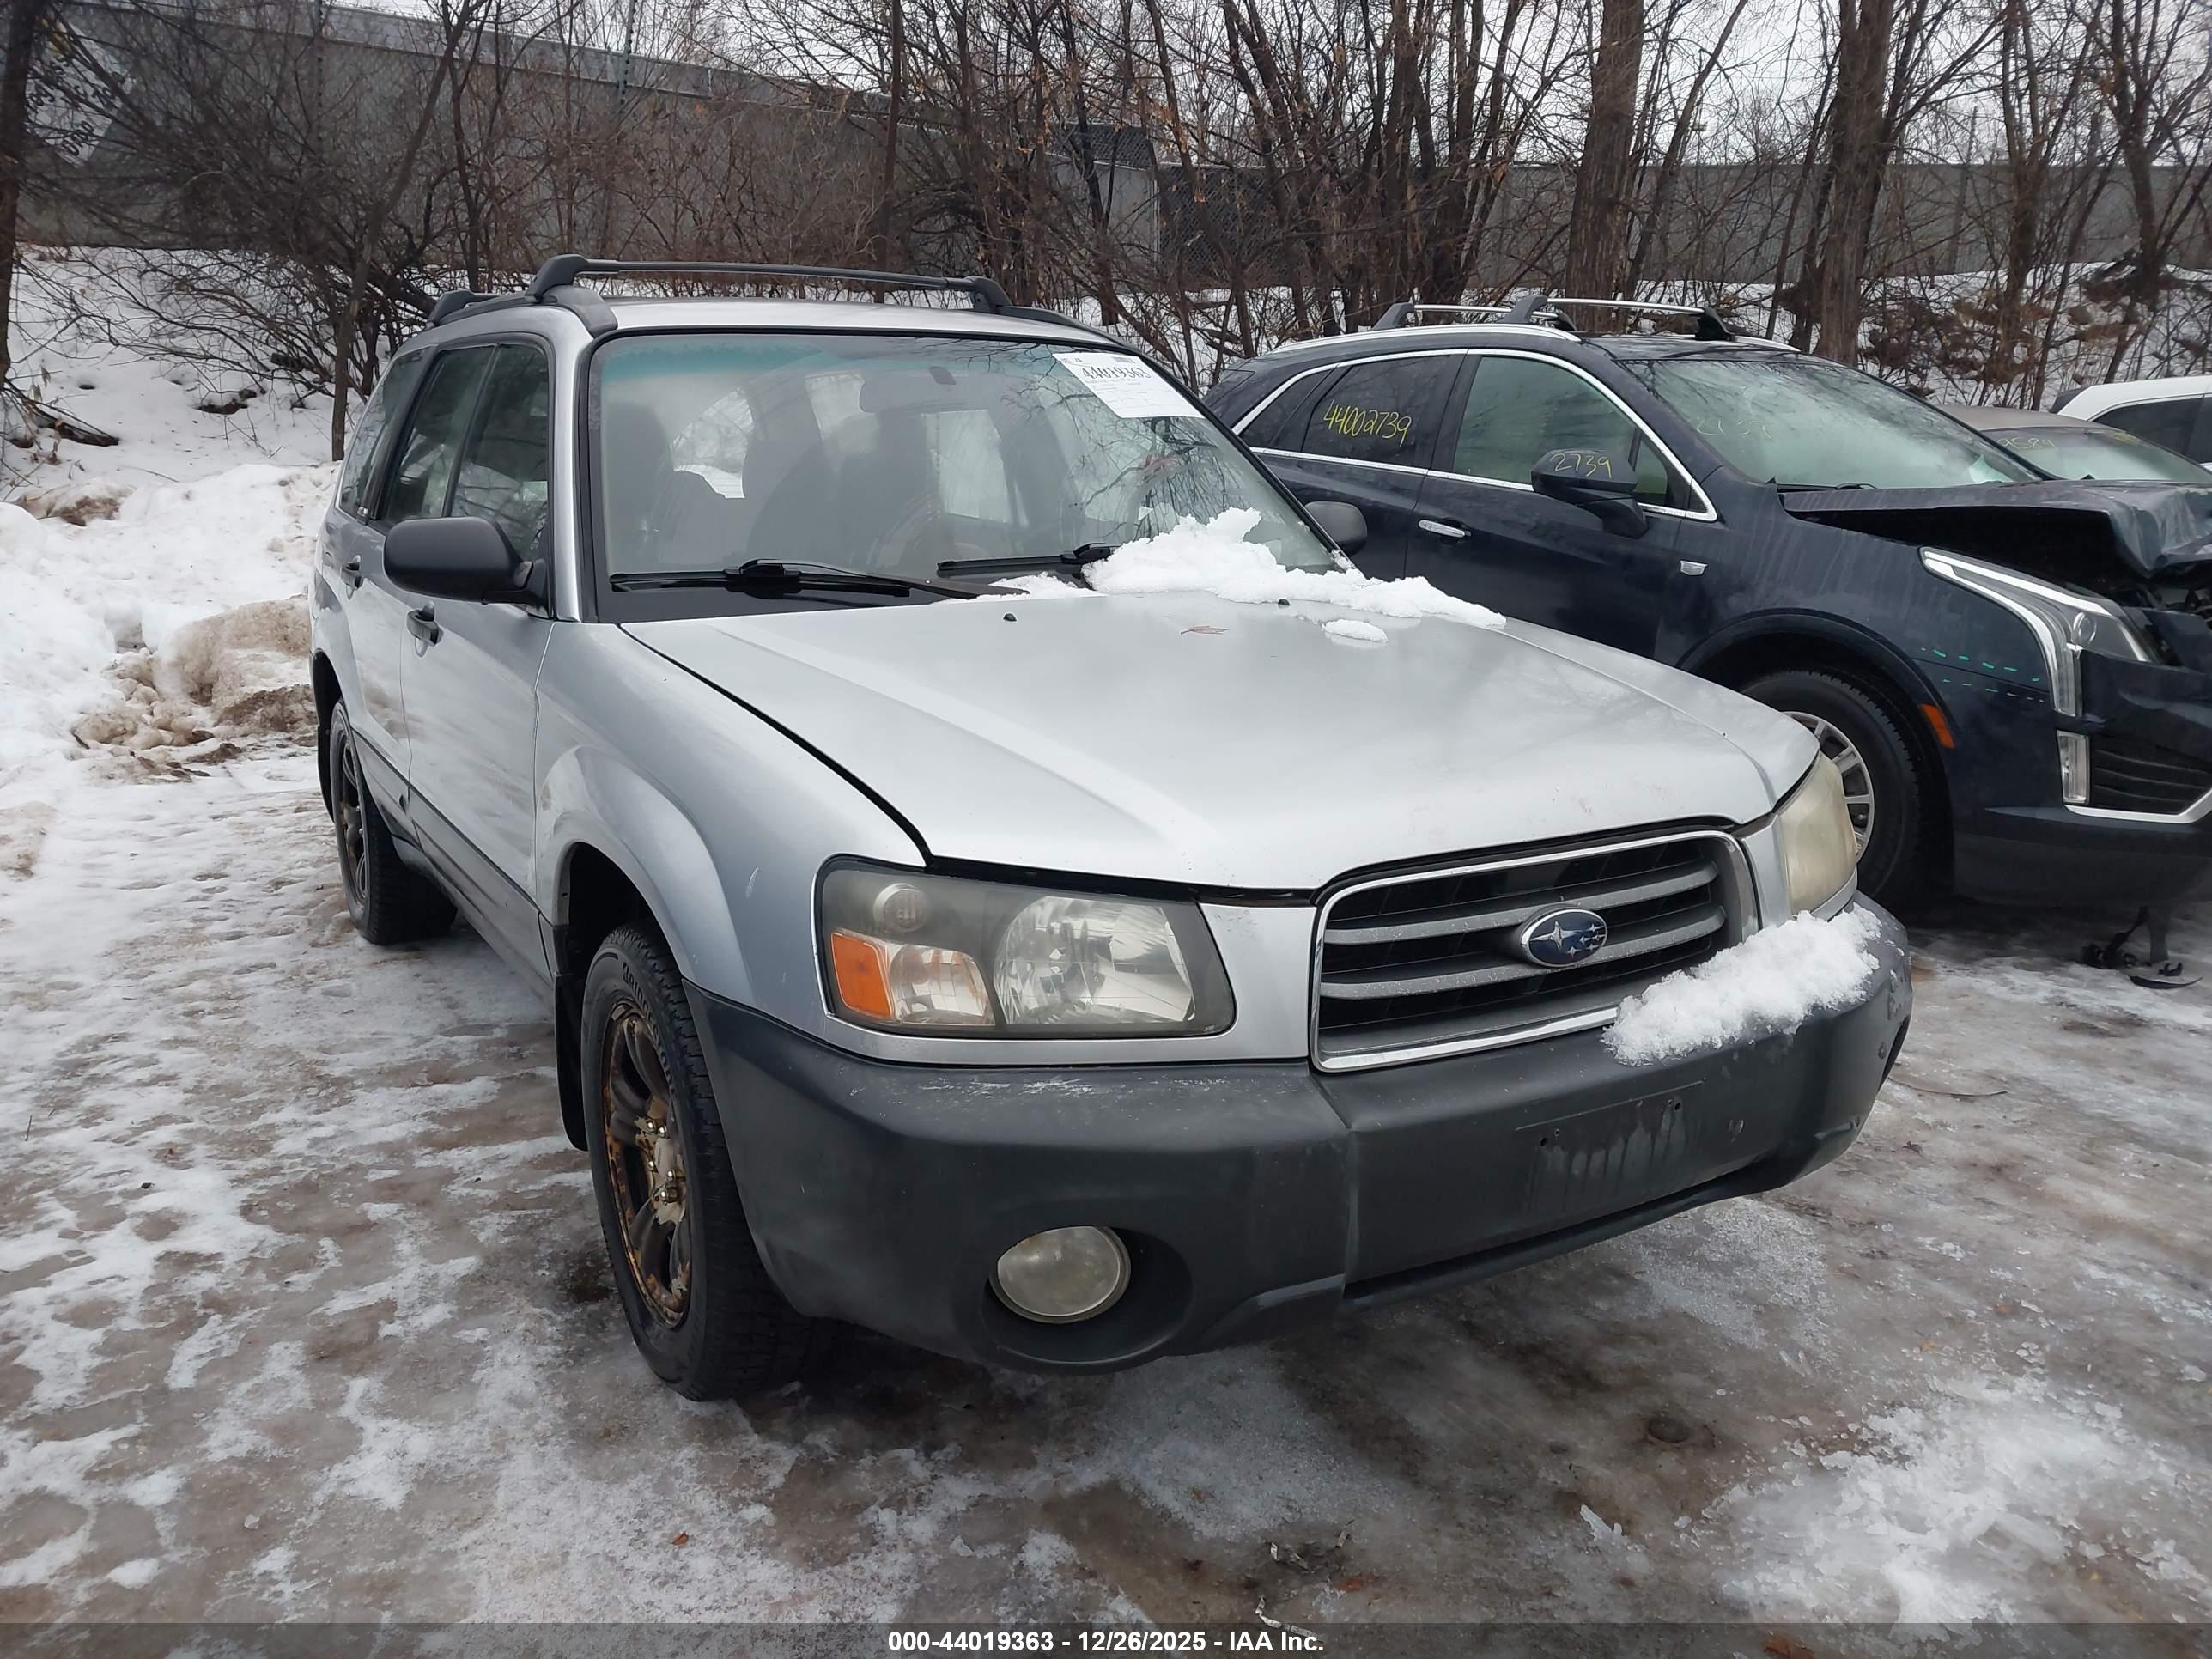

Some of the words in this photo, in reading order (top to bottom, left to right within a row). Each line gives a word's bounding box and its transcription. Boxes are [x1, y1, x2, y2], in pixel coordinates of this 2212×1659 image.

[1081, 366, 1152, 380] 44019363
[1323, 399, 1413, 447] 44002739
[1548, 453, 1613, 479] 2739
